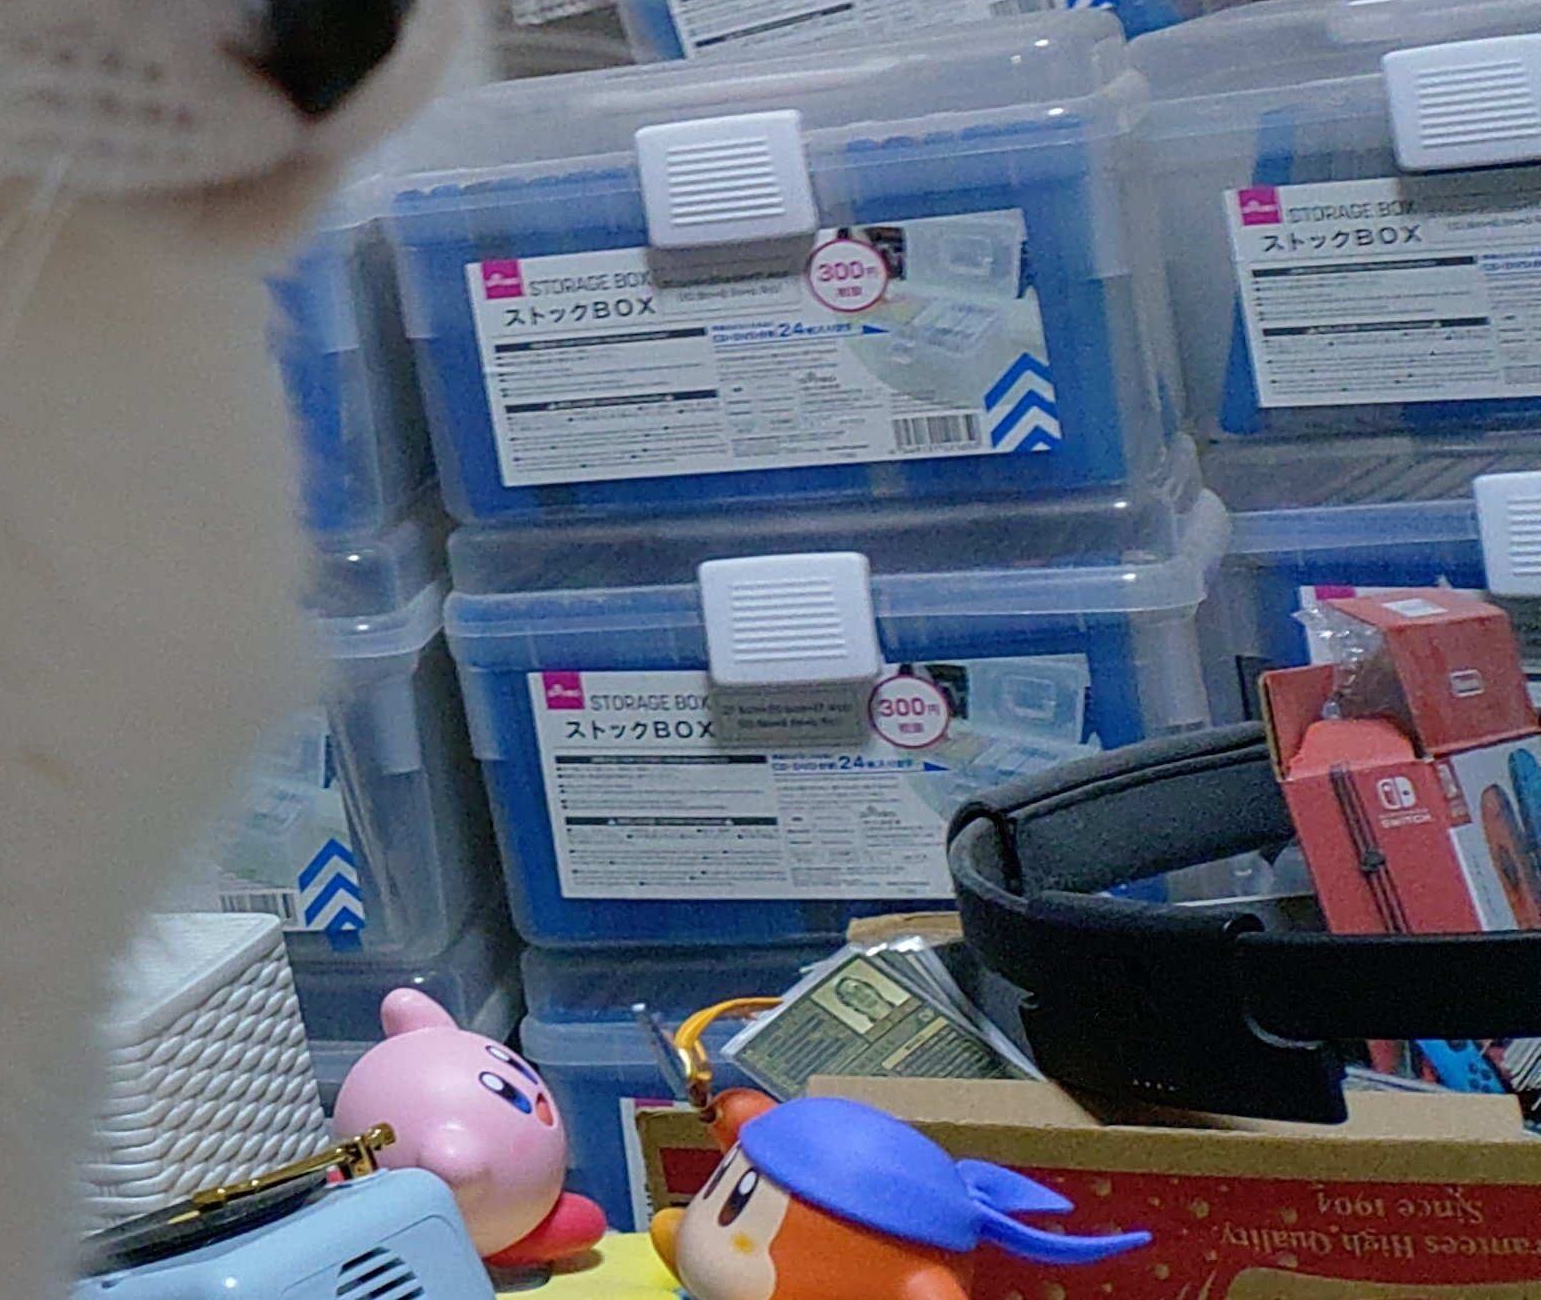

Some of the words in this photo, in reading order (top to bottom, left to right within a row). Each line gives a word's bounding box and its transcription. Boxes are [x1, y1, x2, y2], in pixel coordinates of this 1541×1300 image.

[1288, 203, 1373, 224] STORAGE
[1263, 224, 1422, 253] ストックBOX
[529, 271, 611, 298] STORAGE
[613, 270, 652, 292] BOX
[504, 296, 657, 328] ストックBOX
[590, 694, 669, 712] STORAGE
[565, 718, 714, 741] ストックBOX
[1397, 1195, 1484, 1226] Since
[1219, 1220, 1334, 1255] Quality
[1342, 1230, 1414, 1258] High
